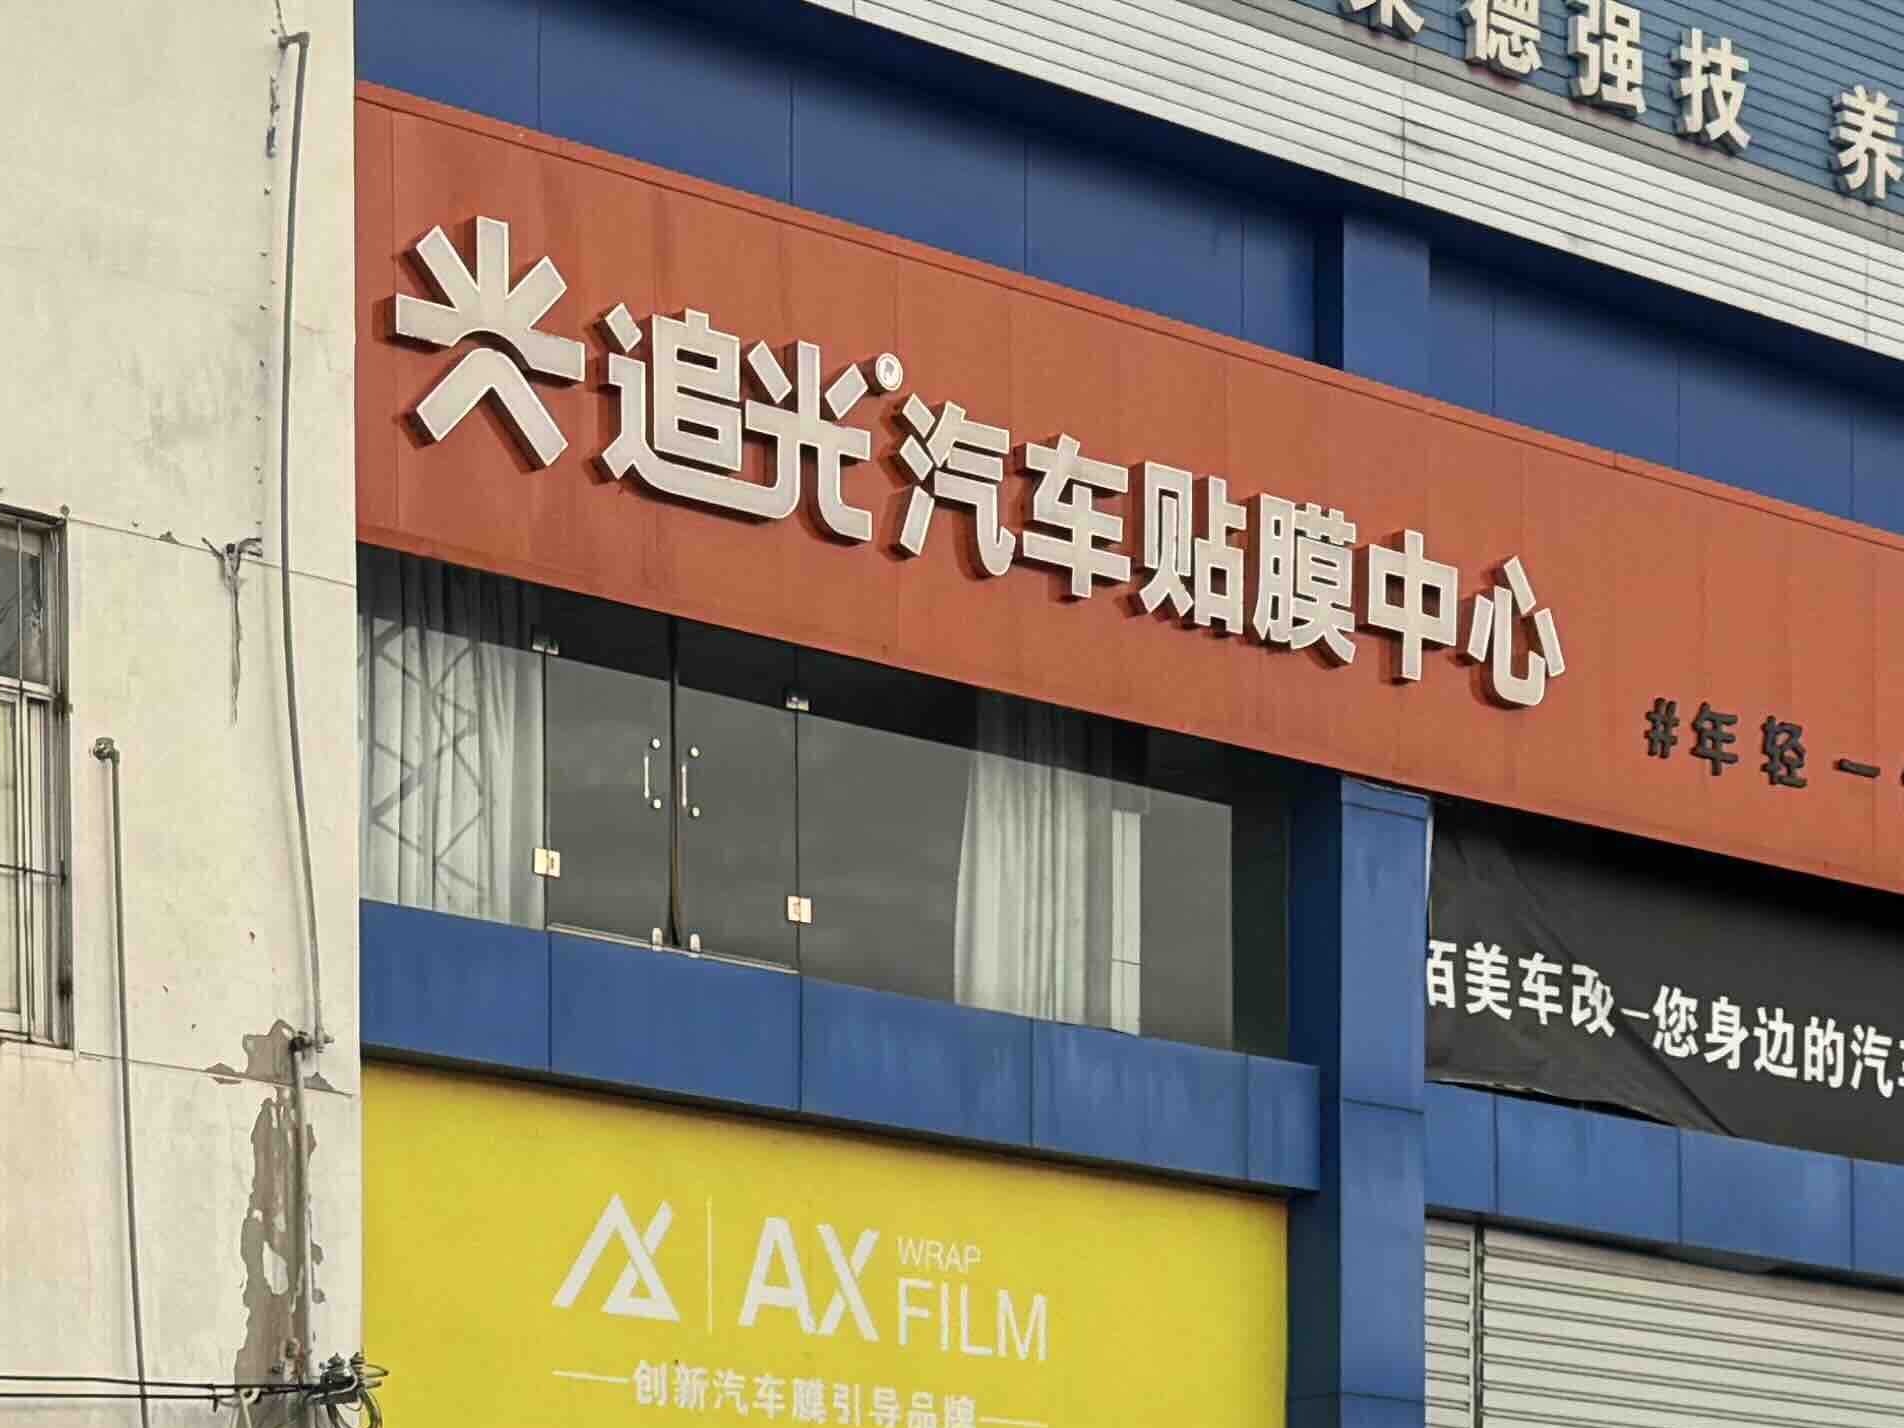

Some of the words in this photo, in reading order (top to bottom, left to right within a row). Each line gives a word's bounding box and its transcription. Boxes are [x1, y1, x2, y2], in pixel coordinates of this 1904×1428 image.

[1339, 0, 1751, 152] 德强技
[738, 1216, 881, 1343] AX
[898, 1236, 983, 1274] WRAP
[898, 1278, 1049, 1361] FILM
